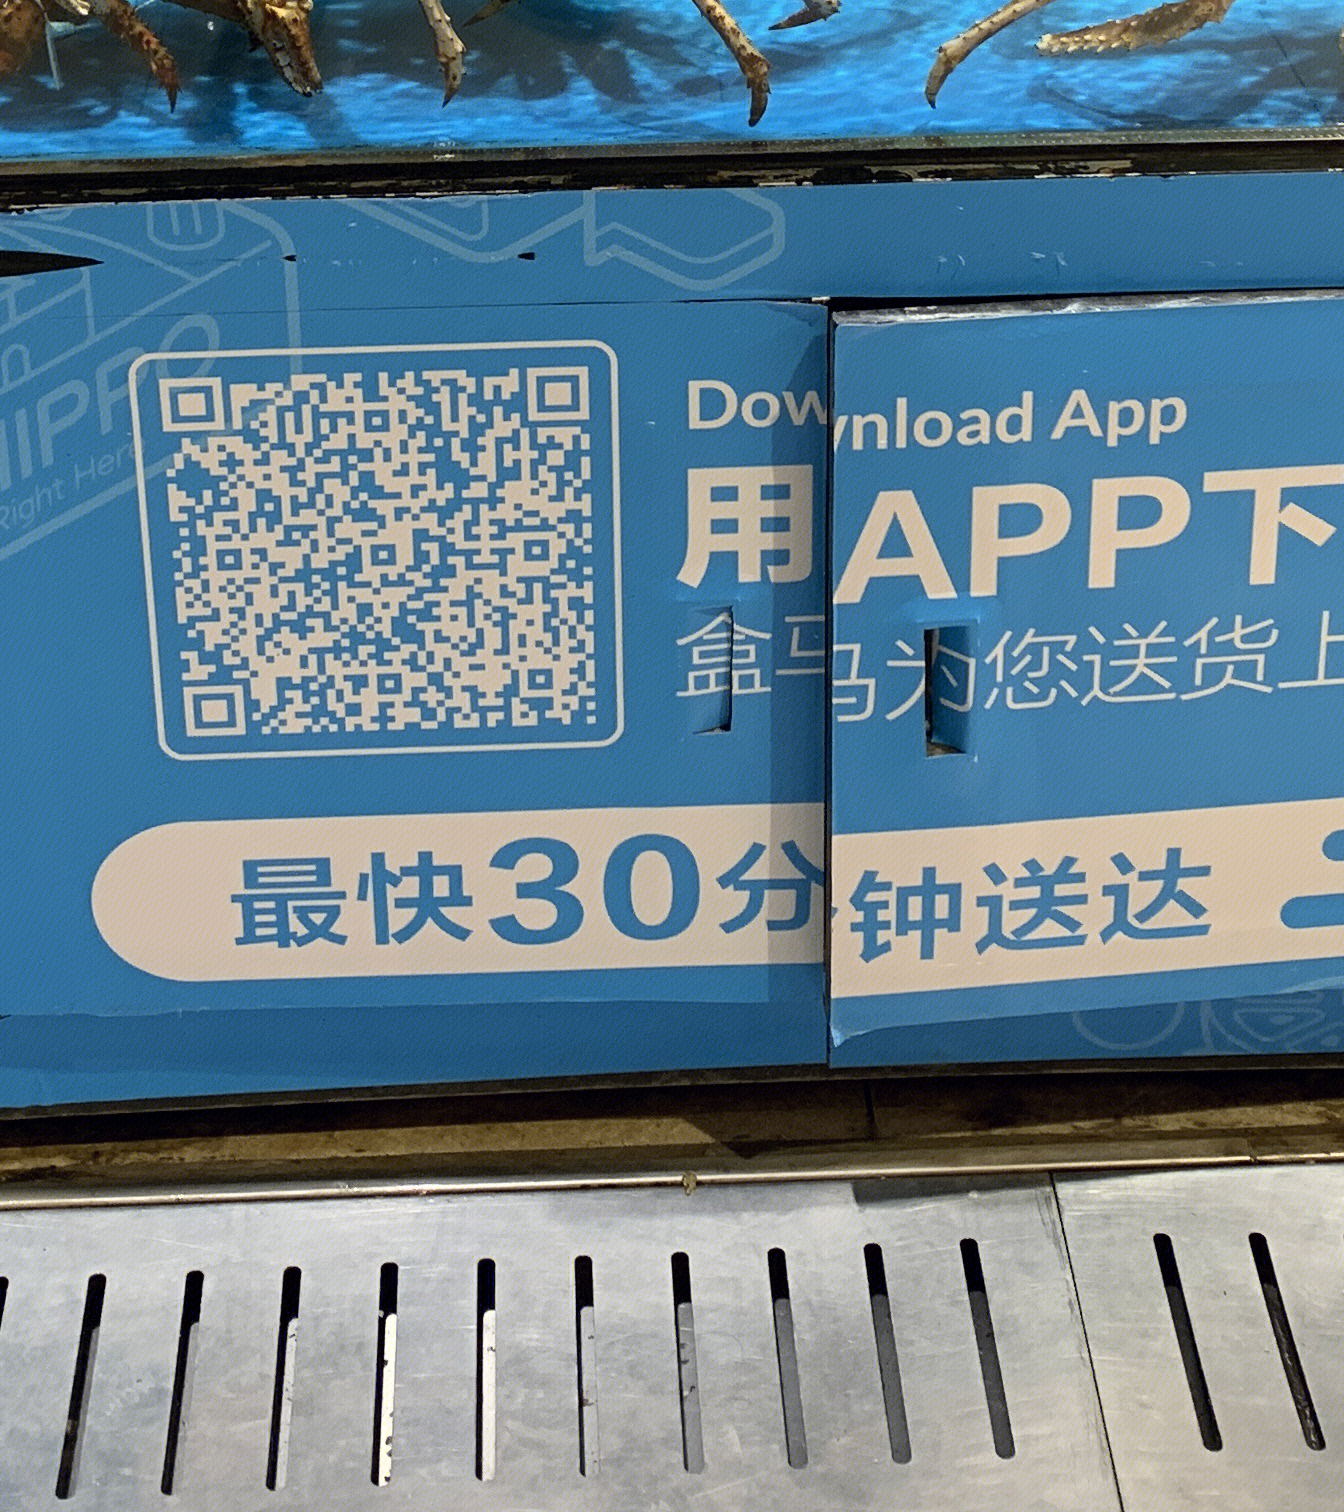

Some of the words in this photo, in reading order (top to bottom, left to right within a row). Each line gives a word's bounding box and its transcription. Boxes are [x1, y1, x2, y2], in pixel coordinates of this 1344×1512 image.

[686, 377, 1035, 450] Download
[1050, 388, 1189, 447] App
[230, 830, 1213, 965] 最快30分钟送达
